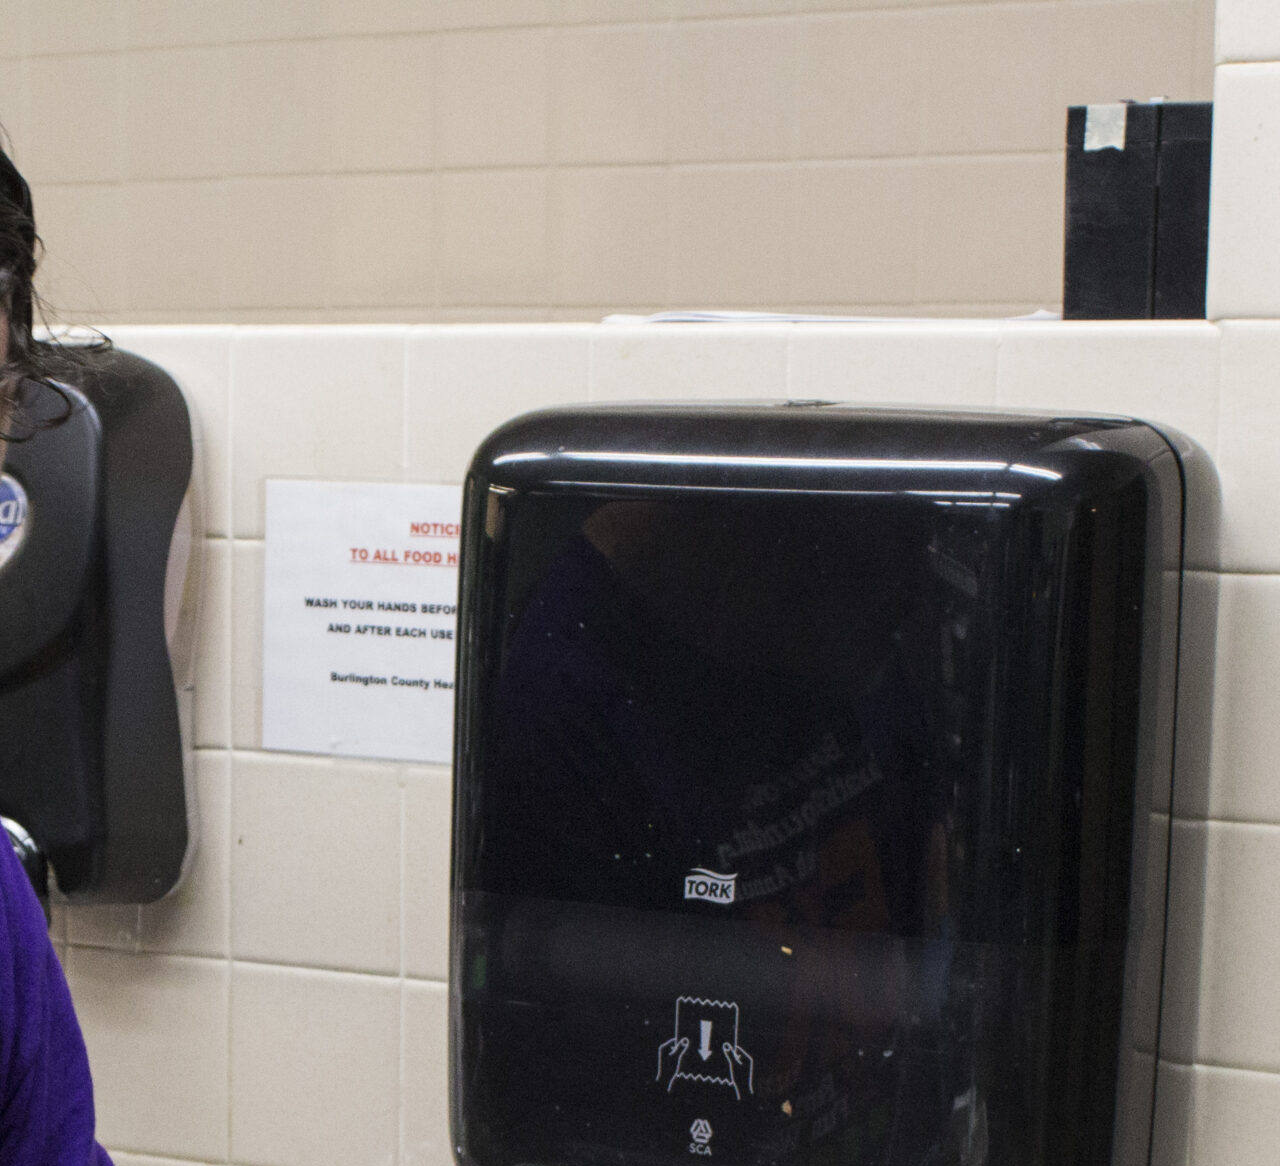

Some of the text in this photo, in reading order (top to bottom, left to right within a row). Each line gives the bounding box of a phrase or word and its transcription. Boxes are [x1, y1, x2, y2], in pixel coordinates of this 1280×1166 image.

[350, 547, 368, 561] TO
[374, 549, 398, 562] ALL
[404, 550, 442, 564] FOOD
[304, 597, 337, 609] WASH
[342, 599, 374, 611] YOUR
[378, 601, 417, 613] HANDS
[327, 623, 453, 640] AND AFTER EACH USE
[330, 672, 387, 686] Burlington
[391, 675, 430, 691] County
[687, 879, 732, 899] TORK
[689, 1142, 712, 1156] SCA
